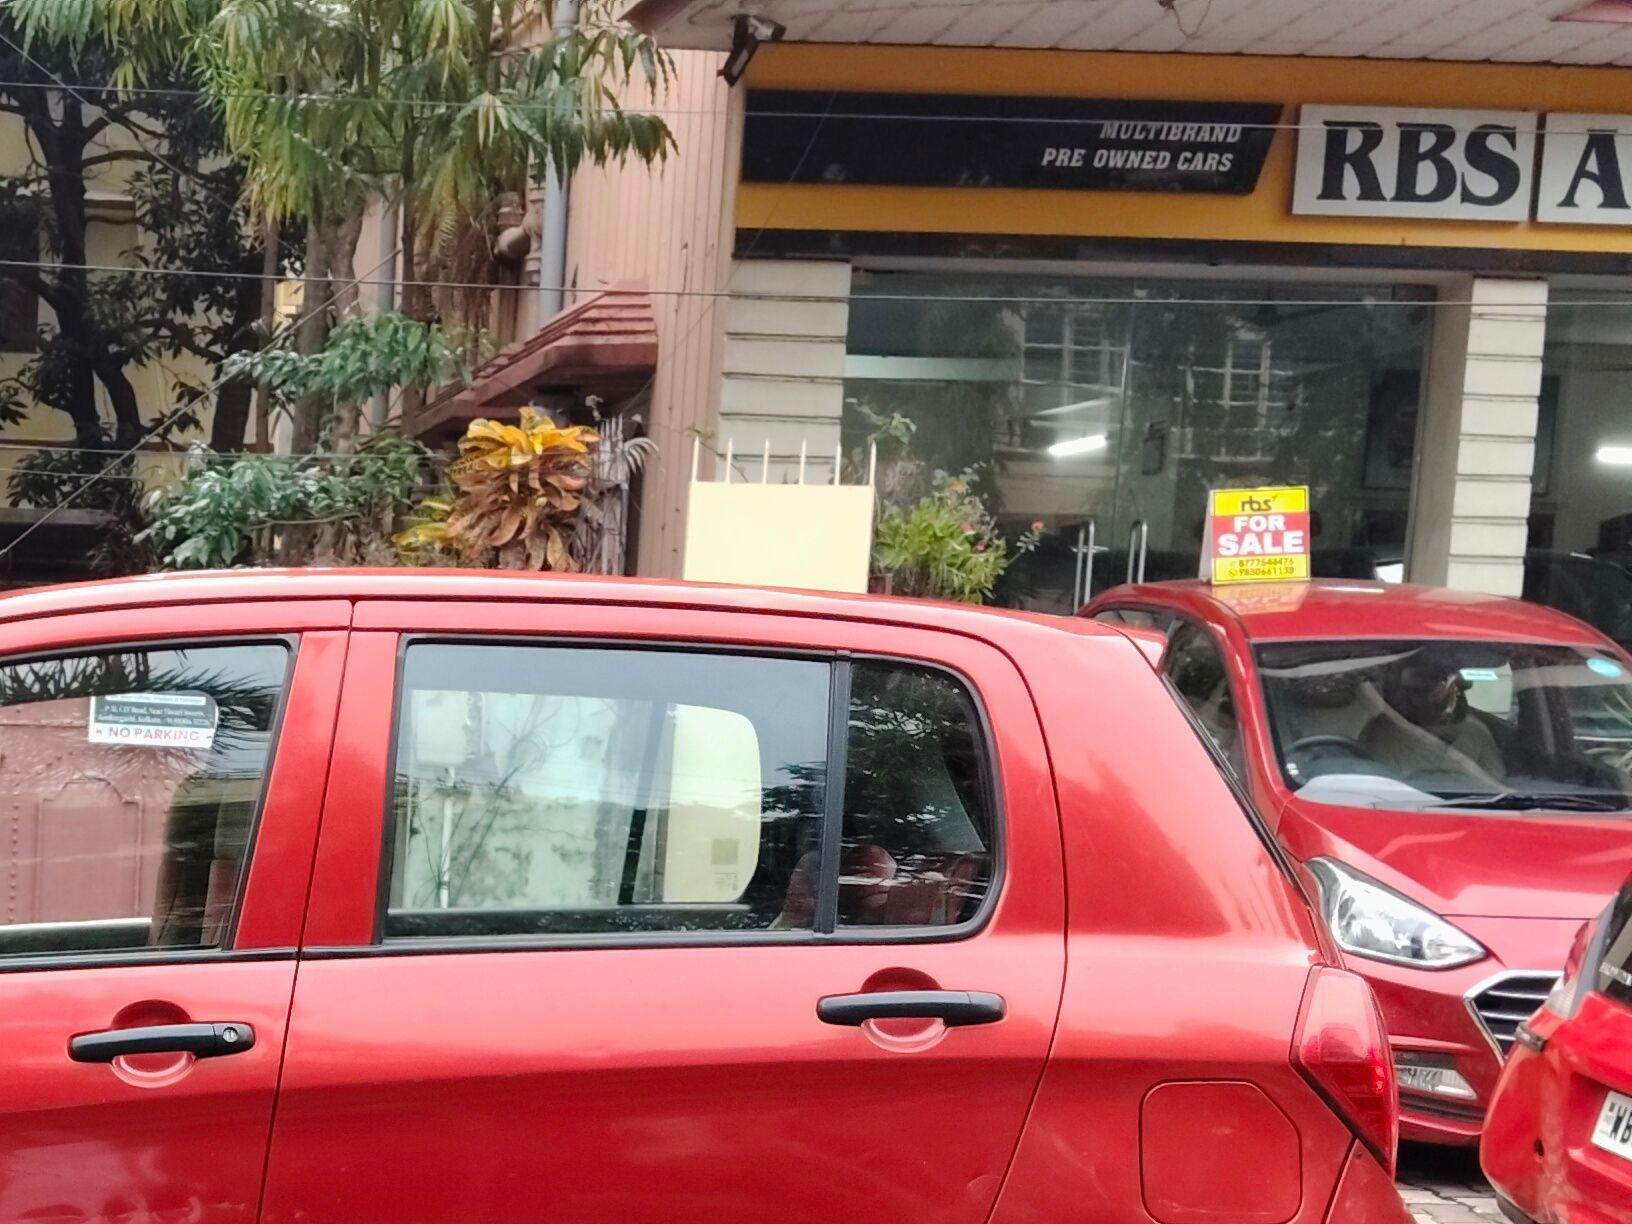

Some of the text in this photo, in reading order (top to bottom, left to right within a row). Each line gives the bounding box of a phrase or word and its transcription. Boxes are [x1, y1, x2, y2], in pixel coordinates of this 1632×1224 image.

[1100, 121, 1242, 143] MULTIBRAND
[1040, 147, 1234, 172] PRE OWNED CARS
[1316, 120, 1632, 210] RBS A
[1241, 496, 1272, 512] rbs
[1233, 515, 1286, 532] FOR
[1218, 531, 1305, 556] SALE
[109, 727, 200, 741] NO PARKING
